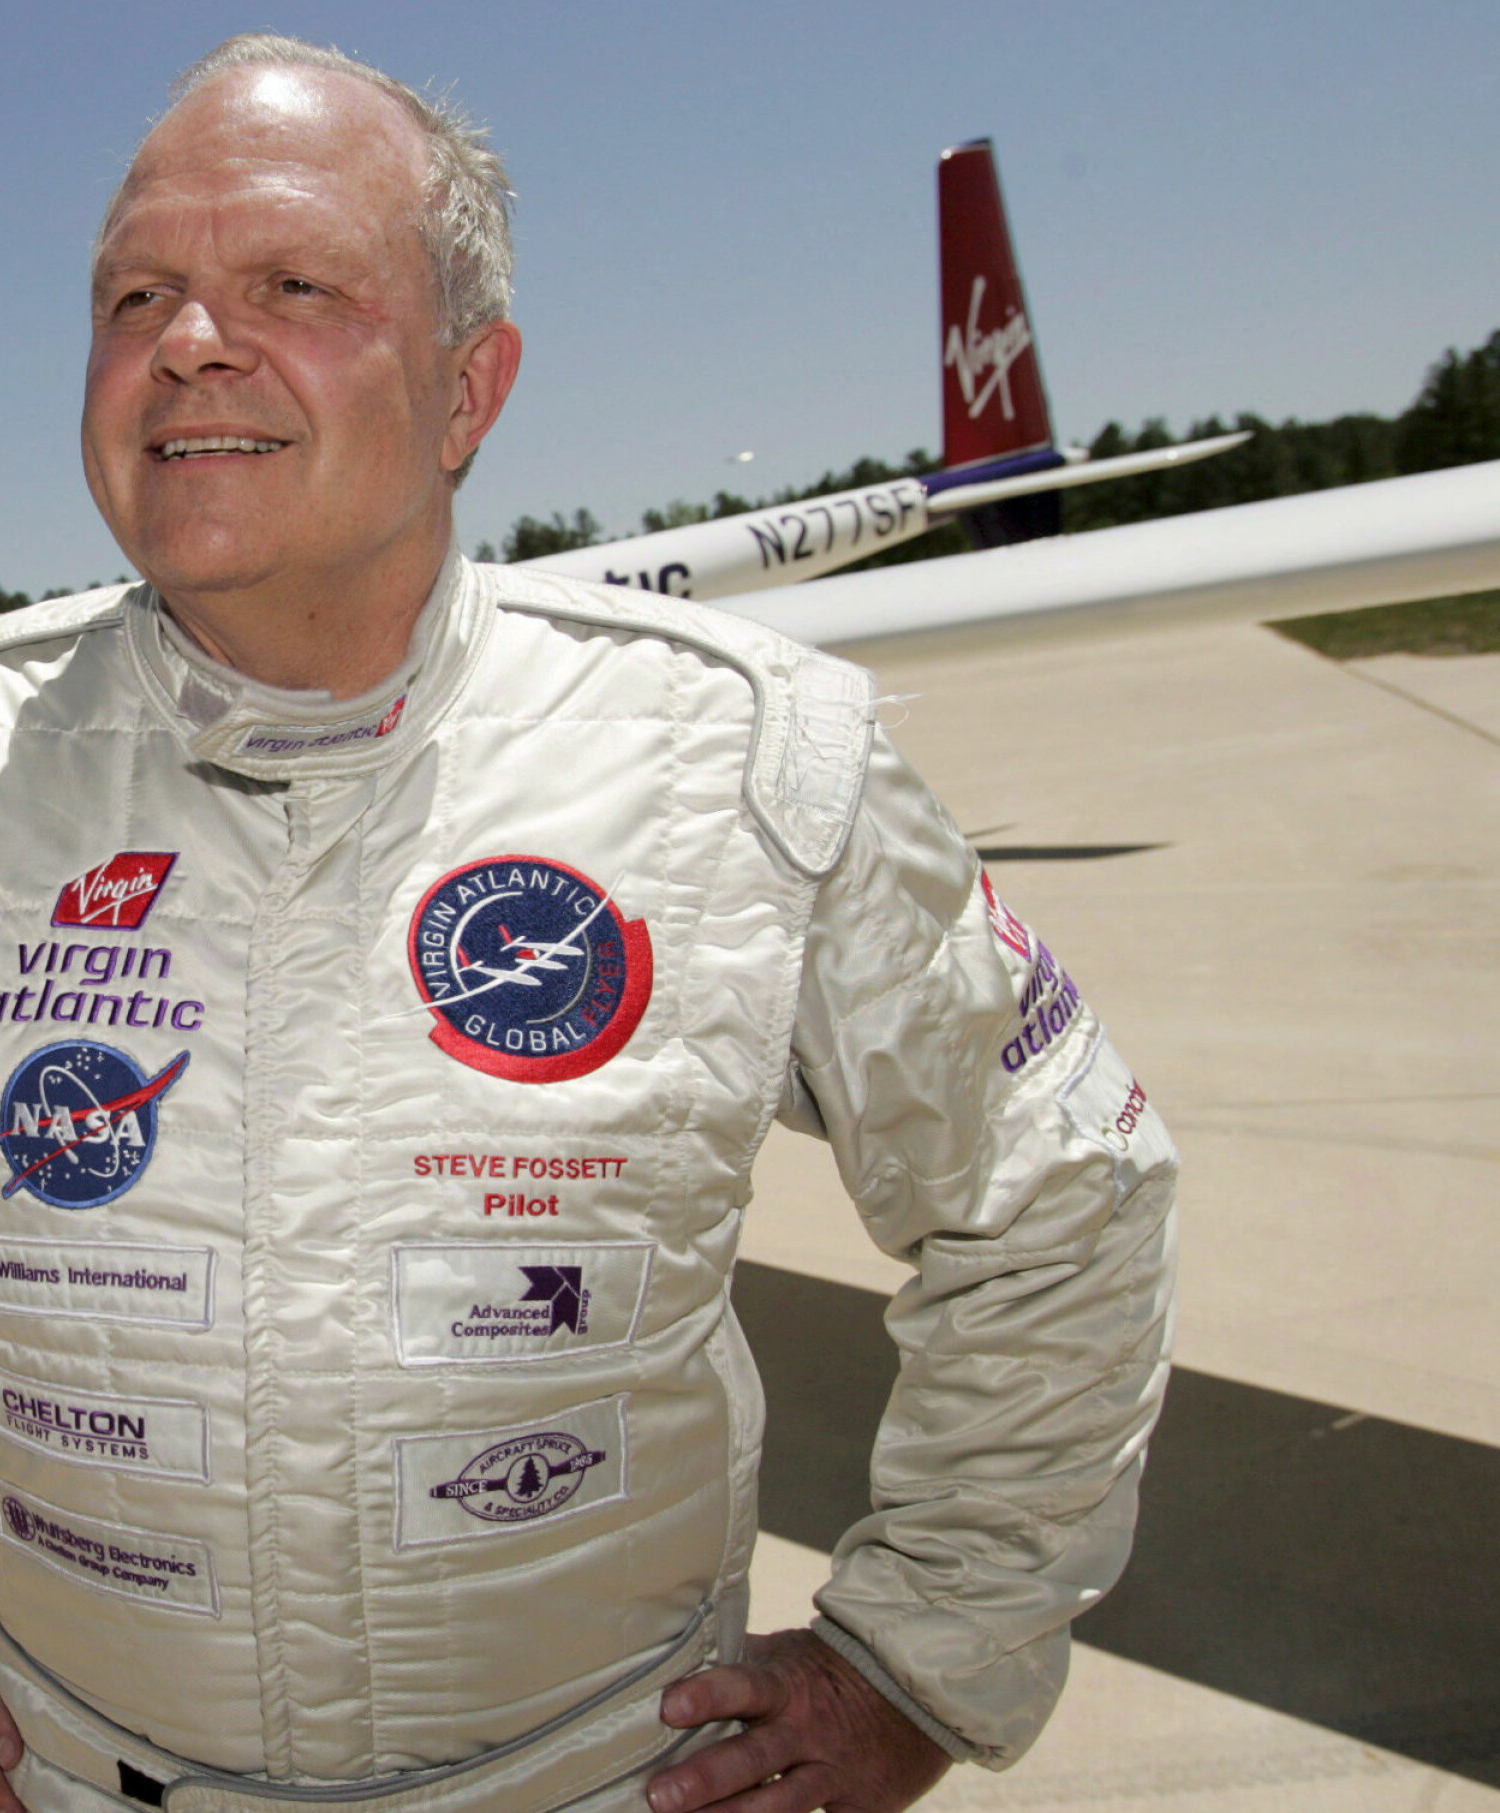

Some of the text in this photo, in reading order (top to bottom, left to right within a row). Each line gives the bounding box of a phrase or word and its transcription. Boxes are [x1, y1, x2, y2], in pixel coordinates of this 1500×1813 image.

[944, 275, 1032, 421] Virgin
[747, 487, 917, 569] N277SF
[70, 857, 159, 926] Virgin
[423, 867, 596, 998] VIRGIN ATLANTIC
[18, 942, 172, 986] virgin
[464, 940, 621, 1052] GLOBAL FLYER
[10, 1102, 146, 1147] NASA
[414, 1154, 628, 1180] STEVE FOSSETT
[484, 1193, 559, 1217] Pilot
[68, 1266, 188, 1293] International
[451, 1322, 550, 1340] Composites
[469, 1304, 550, 1320] Advanced
[2, 1389, 146, 1439] CHELTON
[6, 1416, 149, 1460] FLIGHT SYSTEMS
[479, 1442, 533, 1474] AIRCRAFT
[446, 1481, 488, 1497] SINCE
[108, 1546, 197, 1576] Electronics
